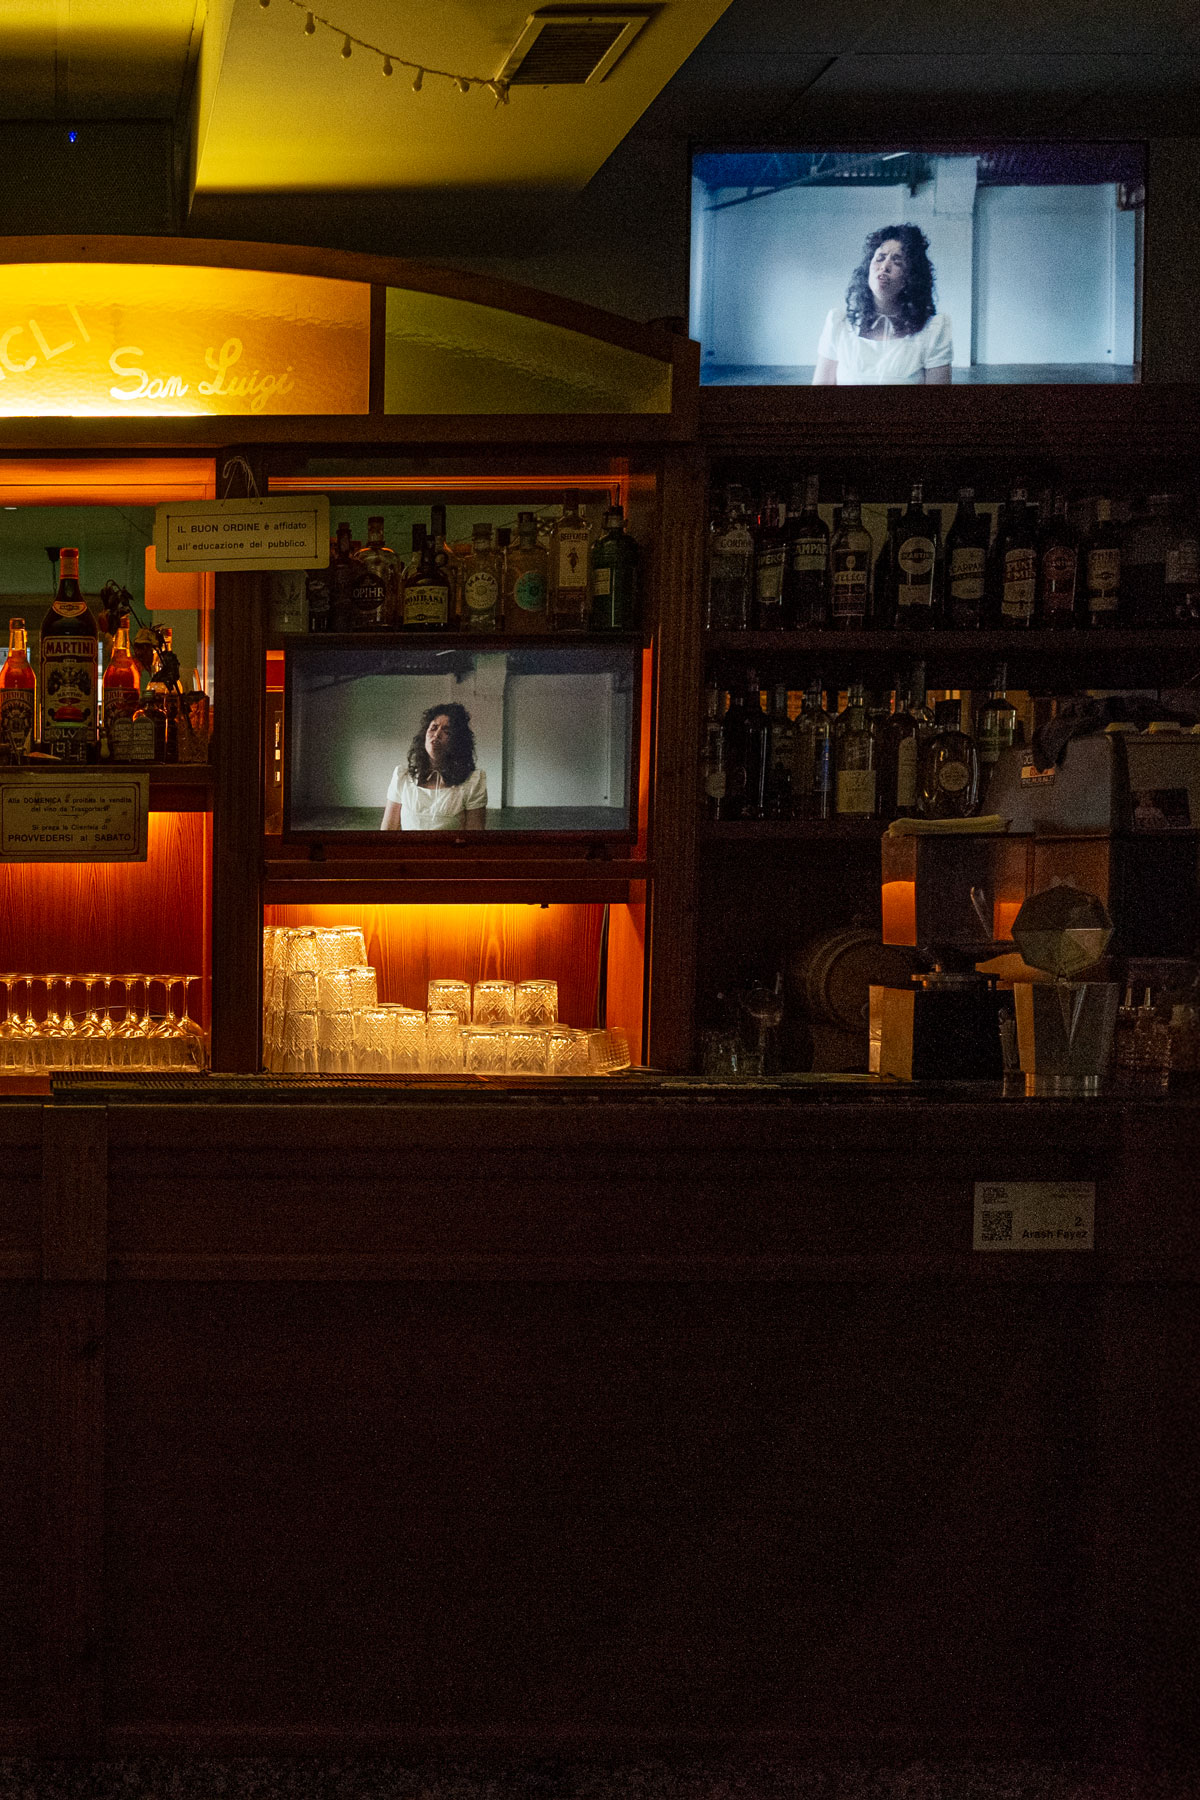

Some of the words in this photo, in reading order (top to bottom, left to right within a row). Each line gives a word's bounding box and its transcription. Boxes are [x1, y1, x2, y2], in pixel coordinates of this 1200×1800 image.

[109, 345, 189, 400] San
[199, 337, 295, 411] Luigi
[191, 524, 218, 533] BUON
[223, 523, 260, 532] ORDINE
[264, 523, 269, 531] è
[274, 521, 307, 530] affidato
[250, 540, 263, 548] del
[268, 539, 307, 549] pubblico.
[352, 586, 385, 599] OPIHR
[46, 641, 94, 654] MARTINI
[8, 834, 73, 843] PROVVEDERSI
[80, 834, 87, 842] al
[1022, 1229, 1054, 1239] Arash
[1057, 1229, 1088, 1240] Fayez
